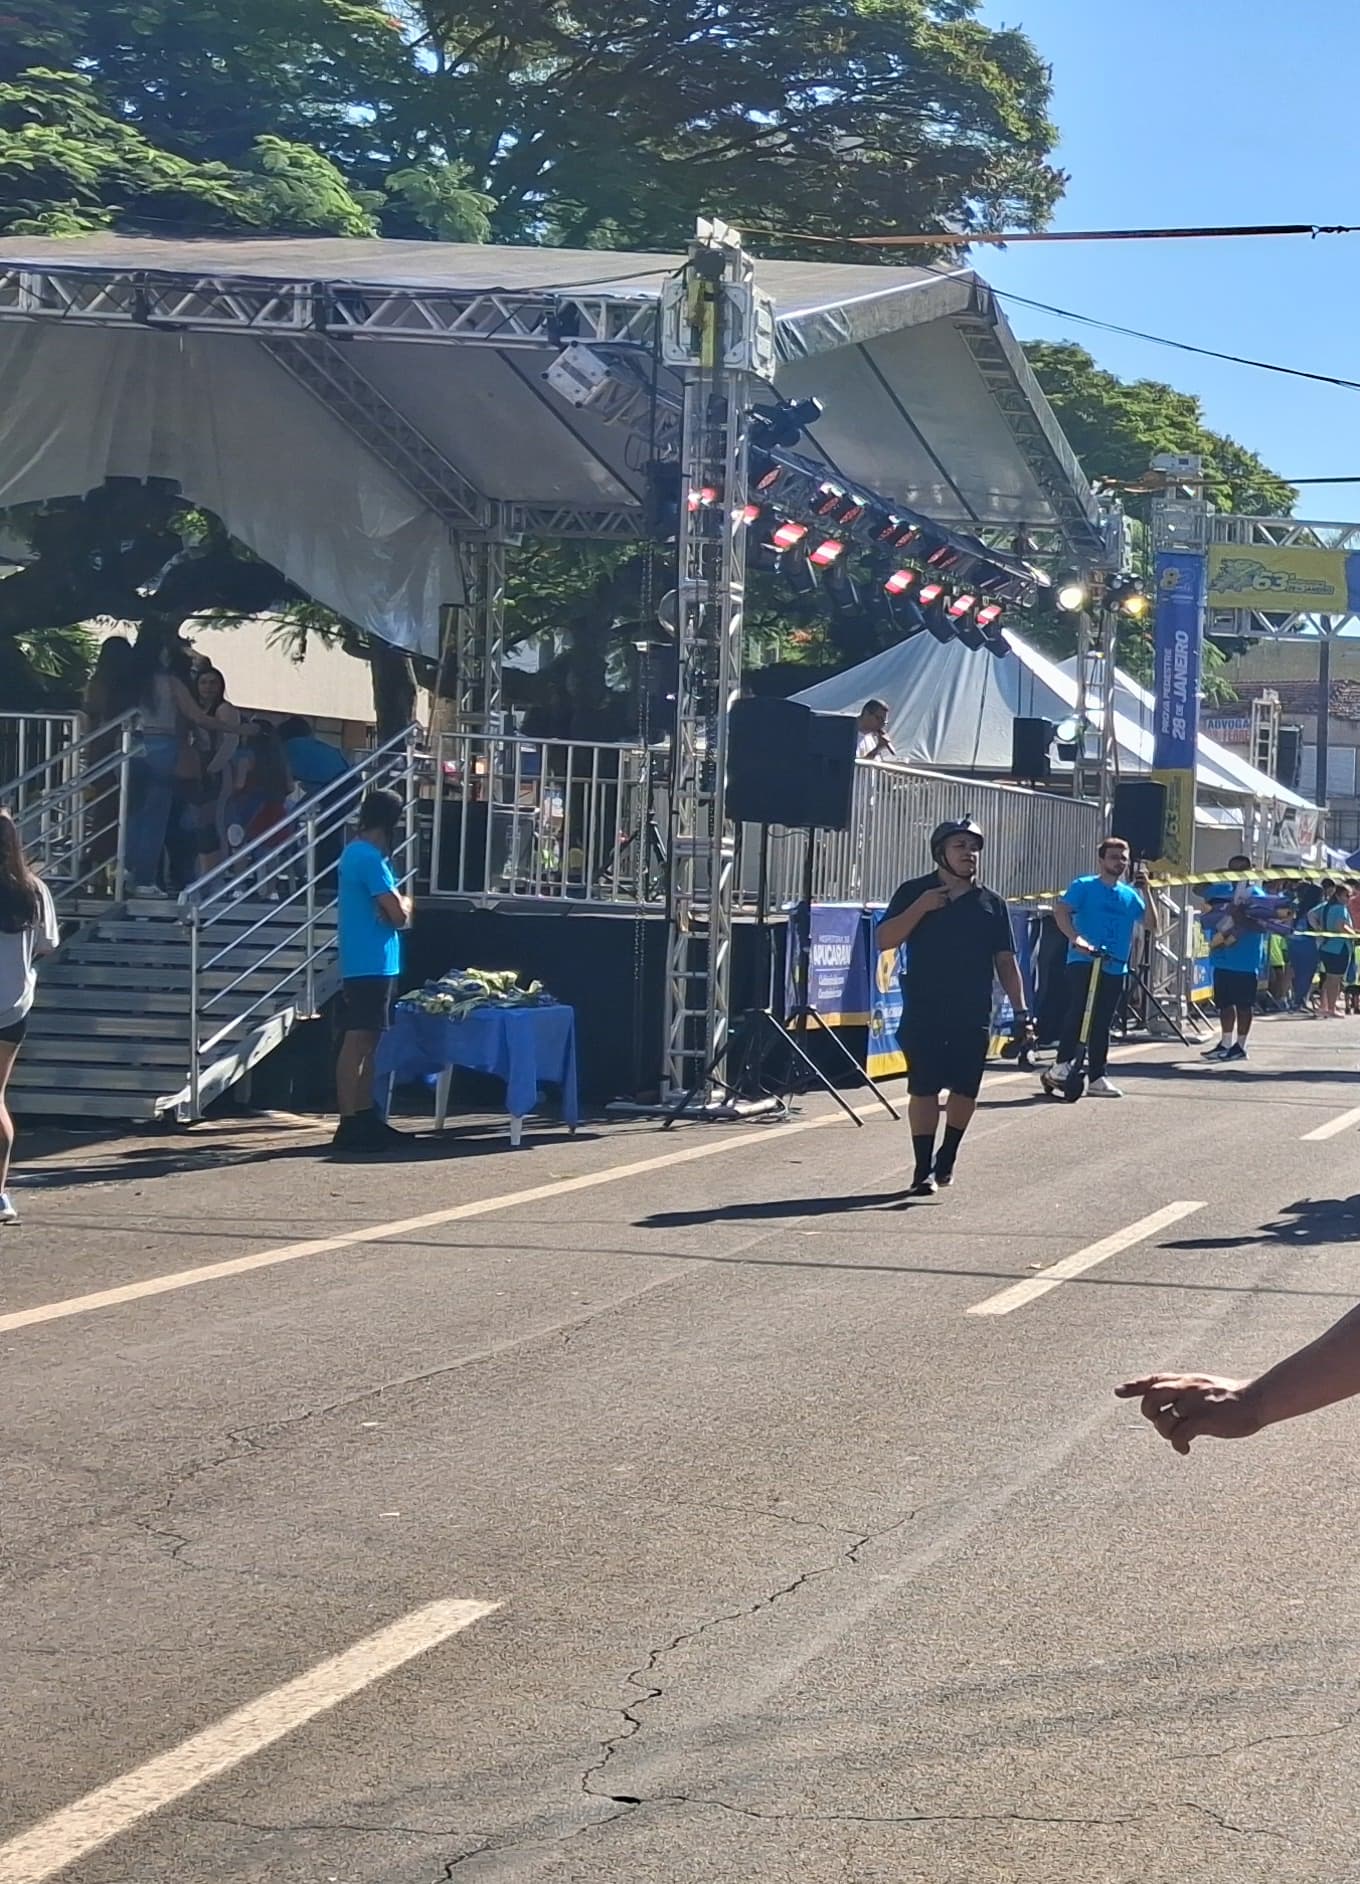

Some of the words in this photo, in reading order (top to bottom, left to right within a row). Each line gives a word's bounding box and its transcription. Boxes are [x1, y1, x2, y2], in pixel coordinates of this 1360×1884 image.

[1173, 630, 1190, 703] JANEIRO
[1172, 717, 1187, 741] 28
[813, 944, 851, 966] APUCARAN
